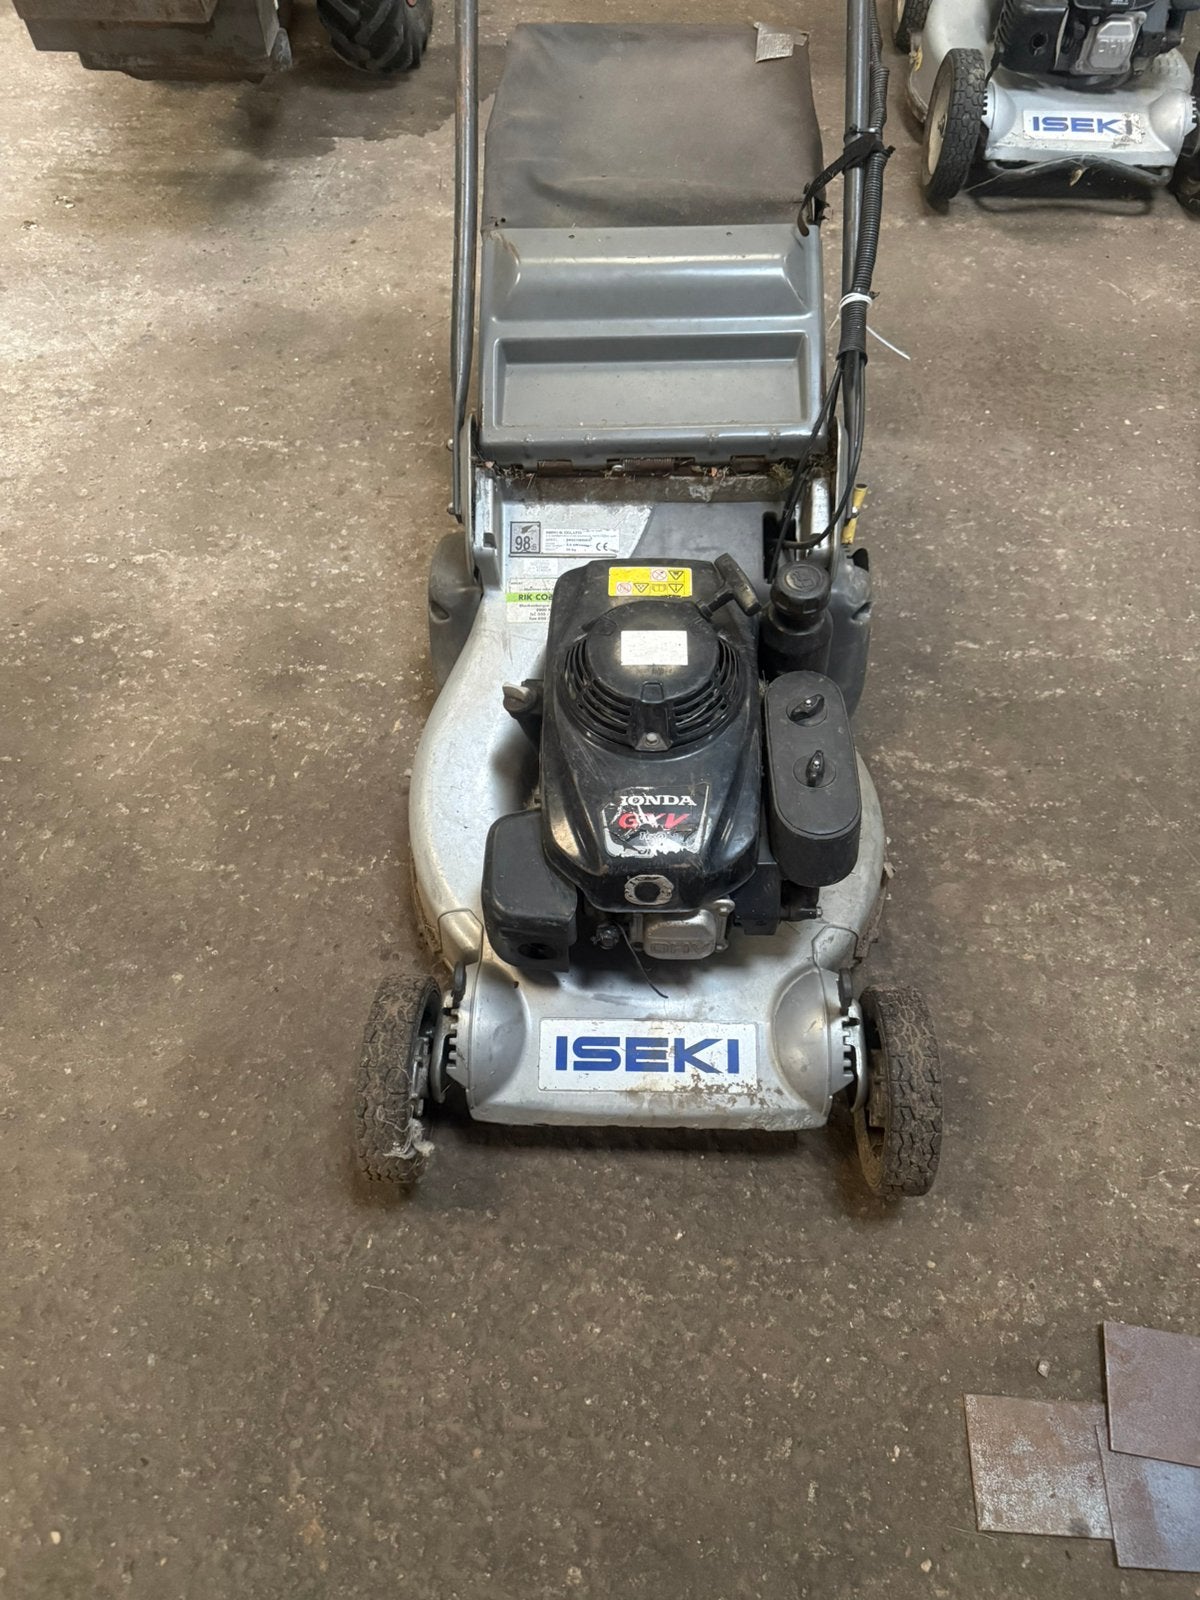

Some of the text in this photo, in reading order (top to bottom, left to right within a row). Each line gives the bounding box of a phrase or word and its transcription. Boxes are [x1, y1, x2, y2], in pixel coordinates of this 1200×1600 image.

[1032, 116, 1133, 135] ISEKI
[514, 535, 531, 551] 98
[518, 593, 533, 601] RIK
[555, 1036, 739, 1074] ISEKI
